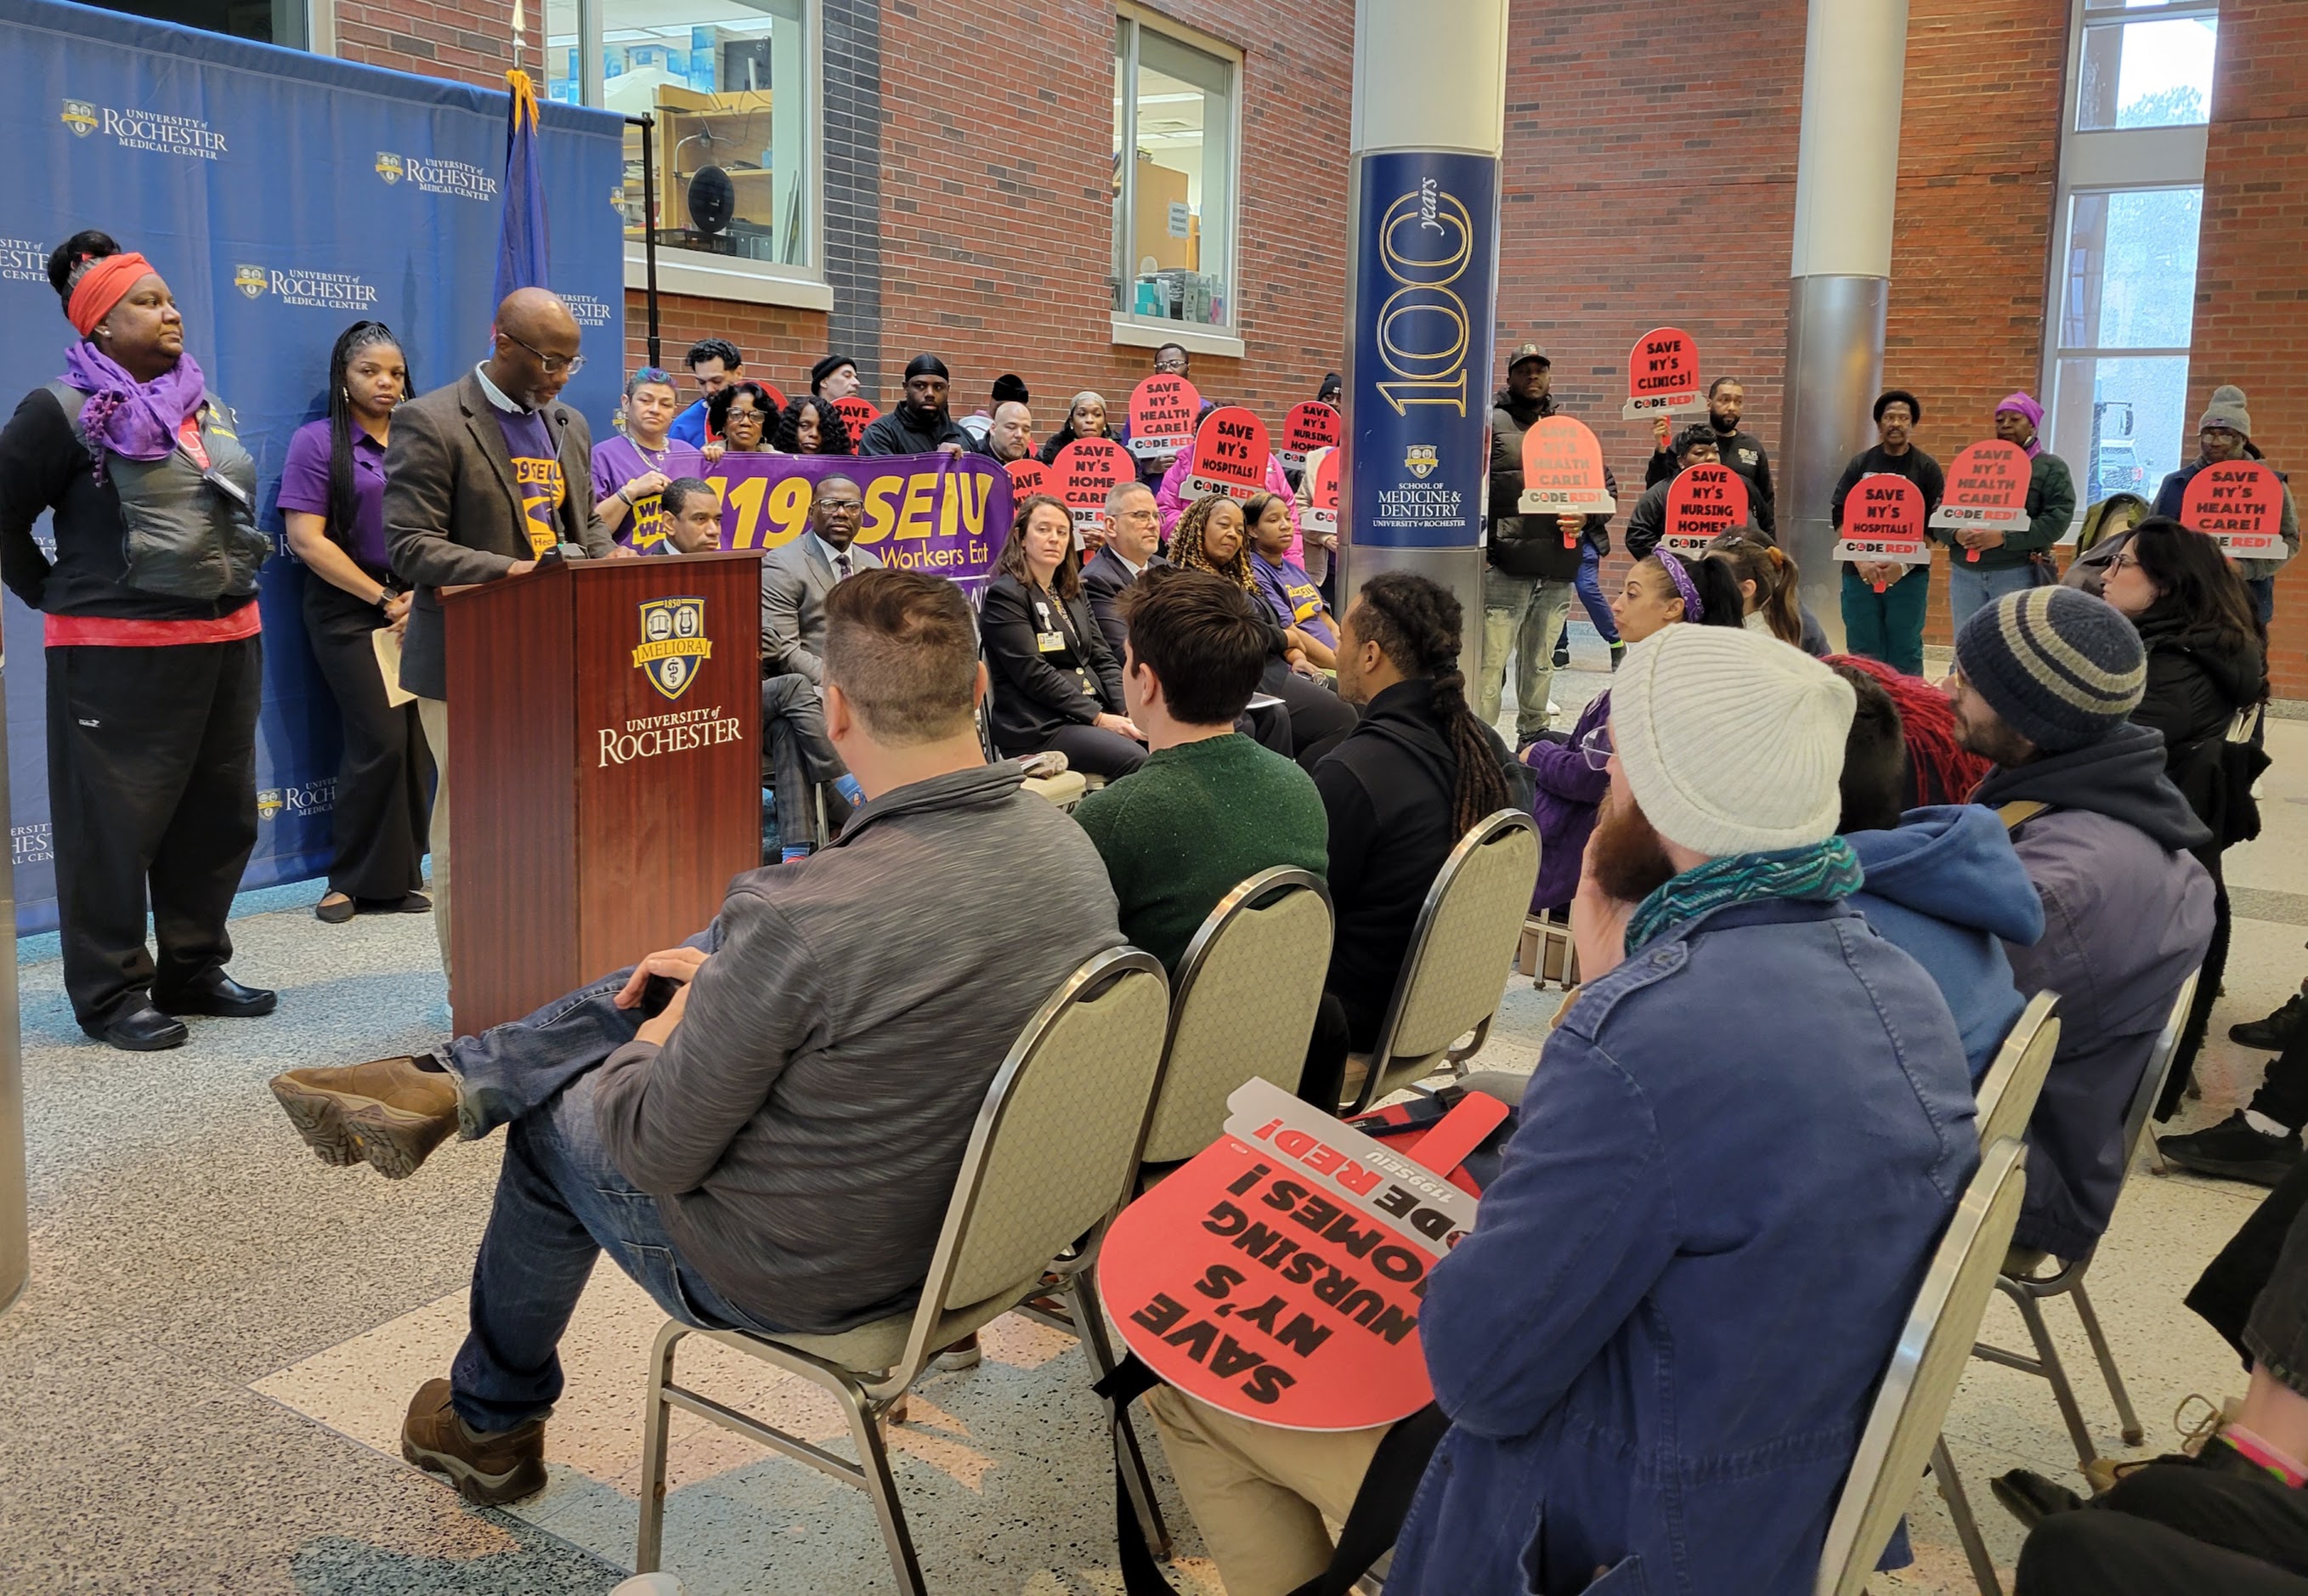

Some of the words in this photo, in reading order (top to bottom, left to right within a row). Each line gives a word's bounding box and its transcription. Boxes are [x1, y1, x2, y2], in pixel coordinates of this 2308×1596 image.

[126, 109, 200, 127] UNIVERSITY
[201, 121, 209, 129] of
[102, 107, 229, 151] ROCHESTER
[118, 137, 170, 153] MEDICAL
[173, 145, 218, 161] CENTER
[405, 158, 498, 194] ROCHESTER
[476, 167, 484, 176] of
[455, 187, 490, 201] CENTER
[1420, 176, 1445, 236] years
[33, 242, 43, 252] of
[3, 269, 51, 282] CENTE
[289, 269, 351, 283] UNIVERSITY
[352, 275, 361, 284] of
[270, 269, 379, 303] ROCHESTER
[283, 296, 327, 308] MEDICAL
[328, 300, 369, 310] CENTER
[1375, 190, 1474, 418] 100
[566, 302, 611, 319] ESTER
[579, 318, 605, 326] ENTER
[1646, 340, 1682, 354] SAVE
[1649, 355, 1679, 371] NY'S
[1638, 370, 1692, 389] CLINICS!
[1146, 382, 1181, 393] SAVE
[1149, 393, 1179, 406] NY'S
[1633, 397, 1667, 410] CODE
[1668, 394, 1696, 406] RED!
[1140, 408, 1191, 421] HEALTH
[1302, 405, 1331, 418] SAVE
[846, 420, 867, 433] Y'S
[1143, 420, 1189, 433] CARE!
[1217, 420, 1254, 440] SAVE
[1302, 418, 1327, 429] NY'S
[1134, 439, 1168, 449] CODE
[1169, 437, 1195, 447] RED
[1293, 428, 1333, 444] NURSING
[1073, 445, 1114, 457] SAVE
[1216, 440, 1248, 459] NY'S
[1971, 450, 2013, 461] SAVE
[1283, 453, 1306, 463] COD
[1533, 459, 1591, 470] HEALTH
[1075, 460, 1111, 473] NY'S
[1202, 457, 1259, 479] HOSPITALS!
[1971, 461, 2006, 474] NY'S
[1012, 472, 1044, 490] AVE
[1068, 476, 1116, 489] HOME
[1538, 472, 1589, 486] CARE!
[1691, 470, 1728, 484] SAVE
[1957, 478, 2017, 490] HEALTH
[2210, 472, 2260, 483] SAVE
[1193, 479, 1230, 495] CODE
[1230, 486, 1256, 500] RED
[1397, 482, 1433, 490] SCHOOL
[1433, 482, 1445, 490] OF
[1692, 484, 1724, 500] NY'S
[2212, 484, 2253, 499] NY'S
[1377, 490, 1451, 503] MEDICINE
[1530, 492, 1568, 503] CODE
[1865, 488, 1905, 501] SAVE
[1958, 492, 2011, 505] CARE!
[1381, 503, 1460, 517] DENTISTRY
[1680, 503, 1734, 517] NURSING
[1867, 503, 1901, 519] NY'S
[1943, 508, 1983, 519] CODE
[2196, 501, 2267, 515] HEALTH
[1853, 521, 1914, 535] HOSPITALS!
[2198, 517, 2261, 531] CARE!
[1669, 538, 1708, 549] CODE
[1846, 542, 1884, 553] CODE
[1885, 544, 1919, 555] RED!
[2231, 536, 2273, 548] RED!
[880, 539, 964, 569] Workers
[664, 598, 682, 609] 1850
[640, 639, 704, 659] MELIORA
[625, 708, 710, 733] UNIVERSITY
[710, 705, 722, 720] of
[597, 717, 744, 768] ROCHESTER
[305, 777, 339, 790] UNIVER
[298, 803, 334, 817] MEDICA
[1252, 1118, 1385, 1197] RED!
[1365, 1151, 1456, 1203] 1199SEIU
[1225, 1163, 1429, 1300] OMES!
[1201, 1200, 1419, 1346] NURSING
[1193, 1264, 1335, 1359] NY'S
[1129, 1292, 1298, 1405] SAVE
